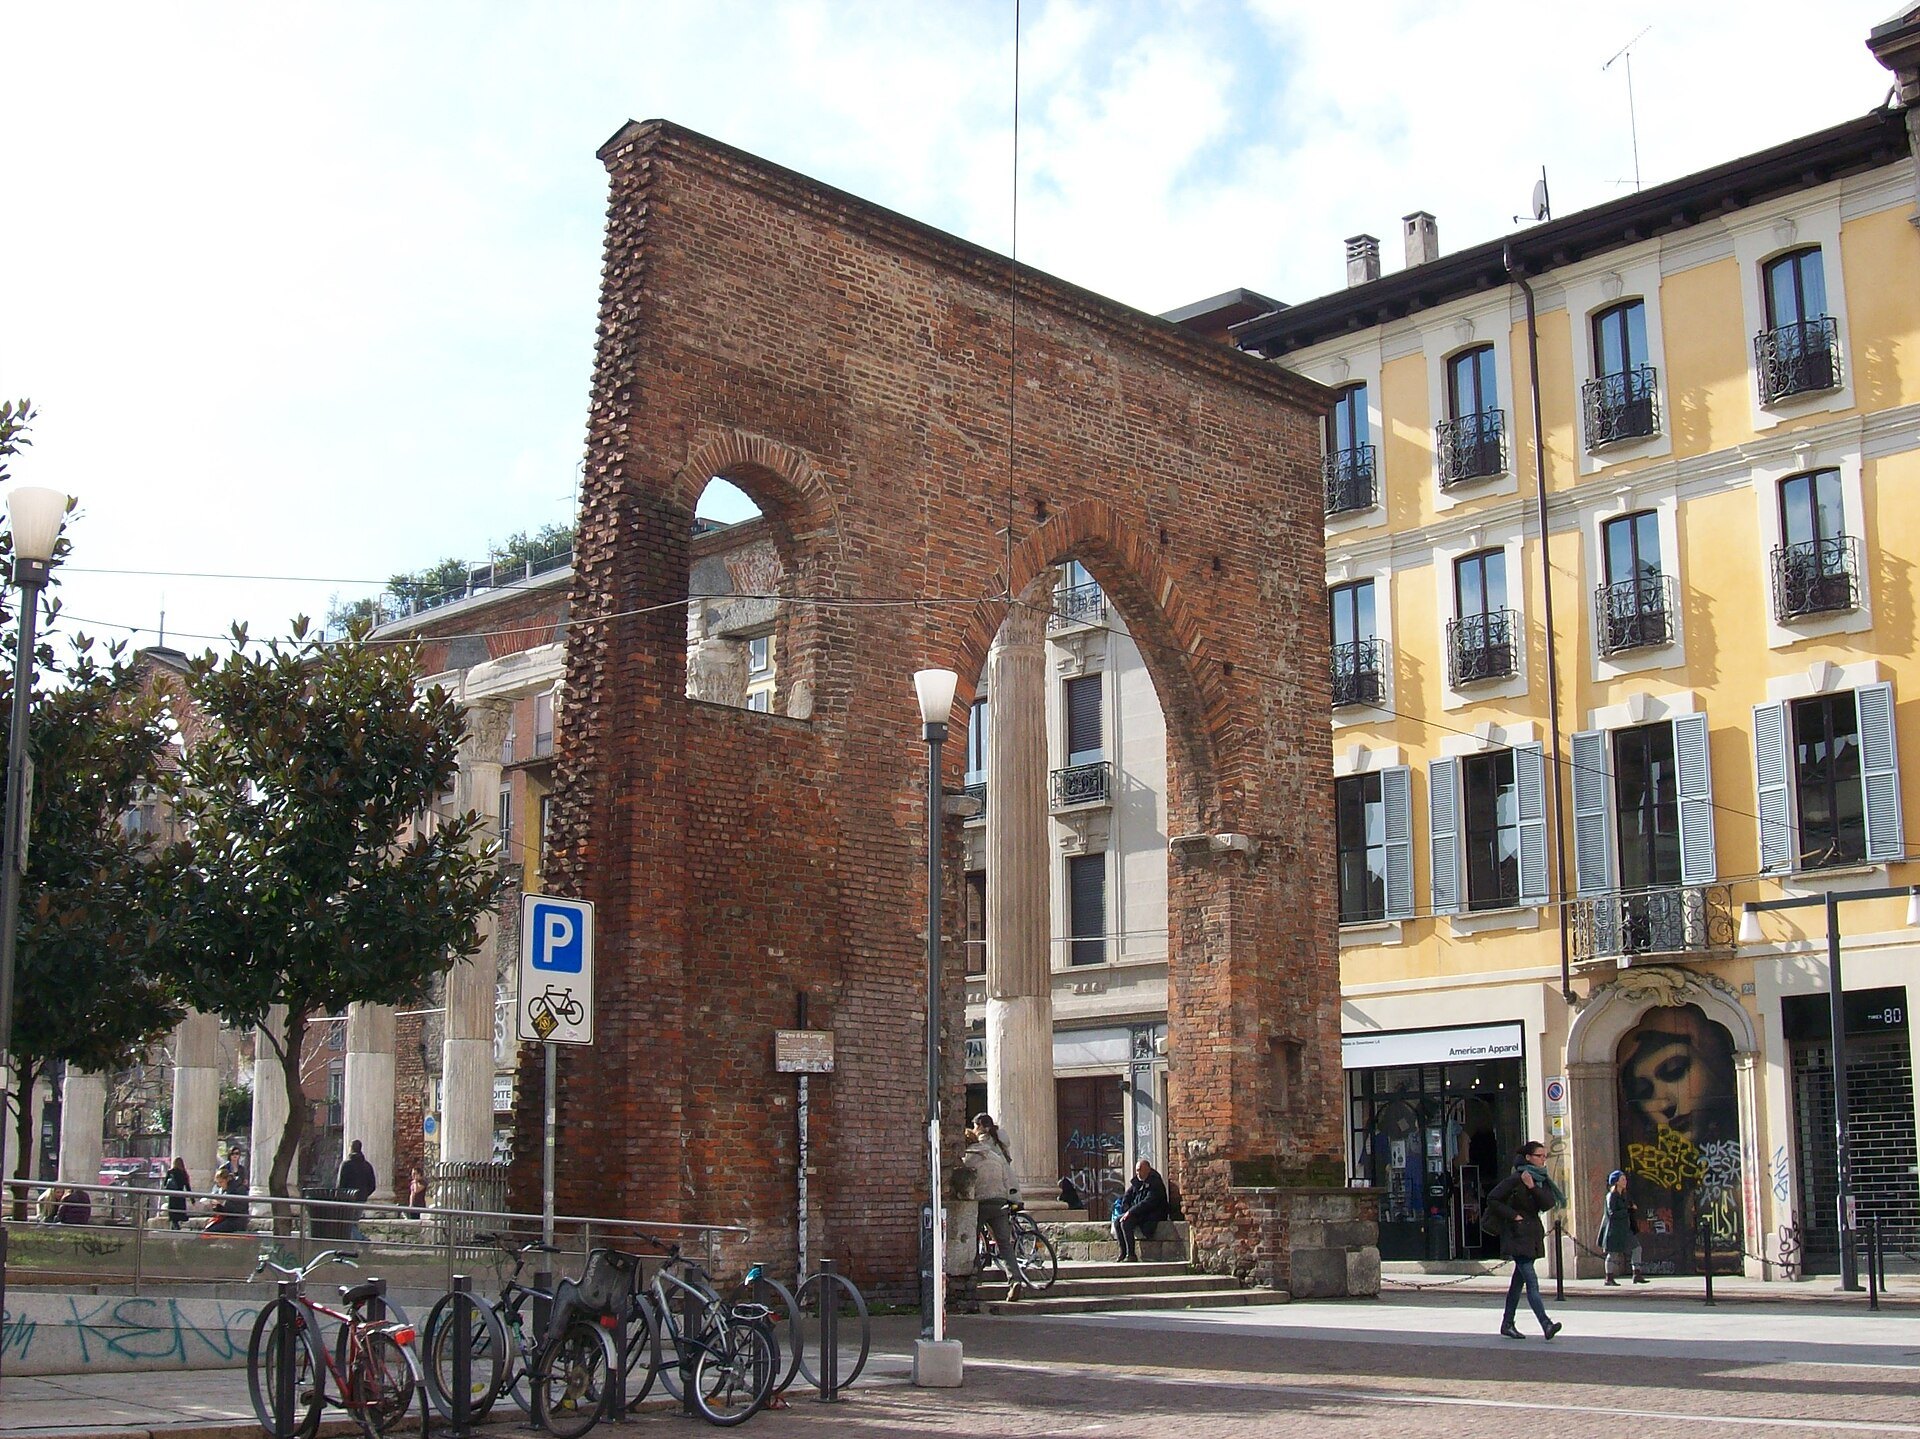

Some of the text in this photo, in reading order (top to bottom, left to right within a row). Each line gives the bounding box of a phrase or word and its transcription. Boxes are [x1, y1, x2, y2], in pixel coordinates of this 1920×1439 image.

[543, 912, 574, 963] P
[1884, 1008, 1902, 1024] 80
[1449, 1042, 1519, 1056] American Apparel
